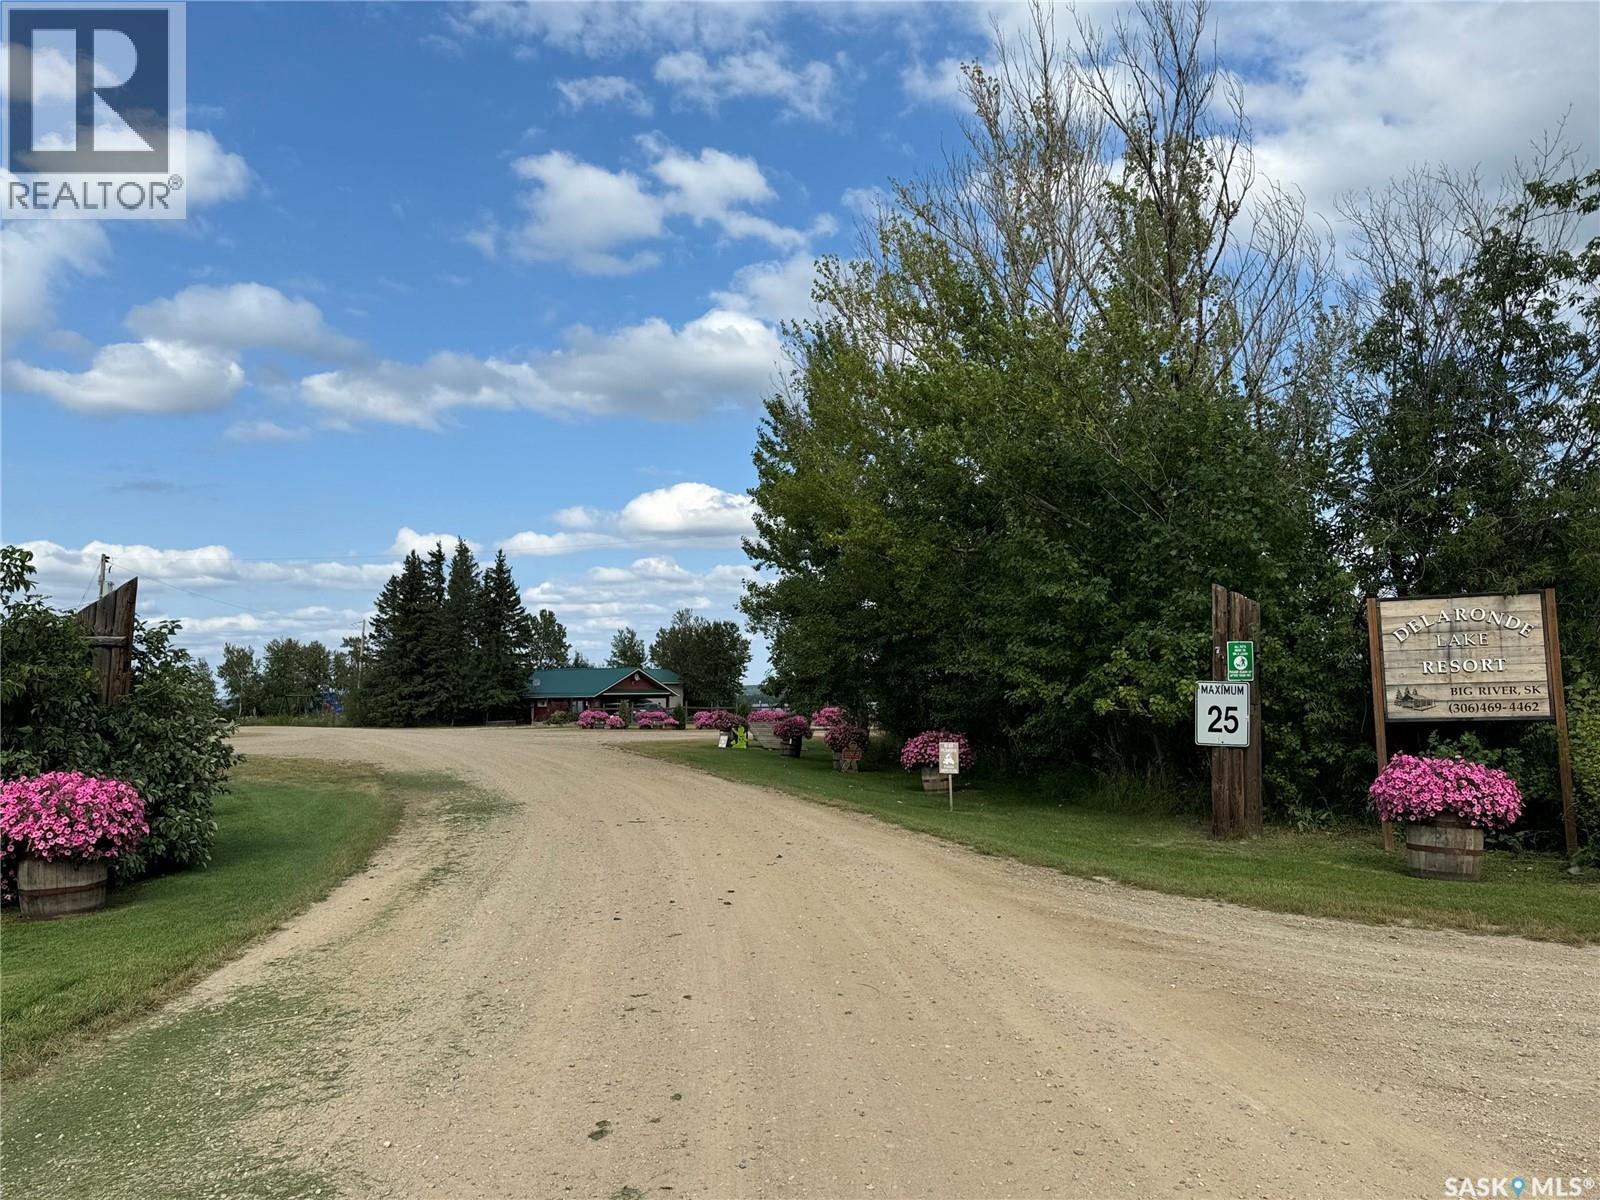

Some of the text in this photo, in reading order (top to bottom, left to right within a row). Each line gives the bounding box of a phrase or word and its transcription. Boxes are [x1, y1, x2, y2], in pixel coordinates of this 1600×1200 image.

[1392, 607, 1535, 643] DELARONDE
[1435, 632, 1489, 648] LAKE
[1422, 658, 1506, 675] RESORT
[1201, 684, 1244, 696] MAXIMUM
[1450, 685, 1542, 697] BIG RIVER, SK
[1448, 702, 1540, 714] (306)469-4462
[1207, 705, 1239, 734] 25
